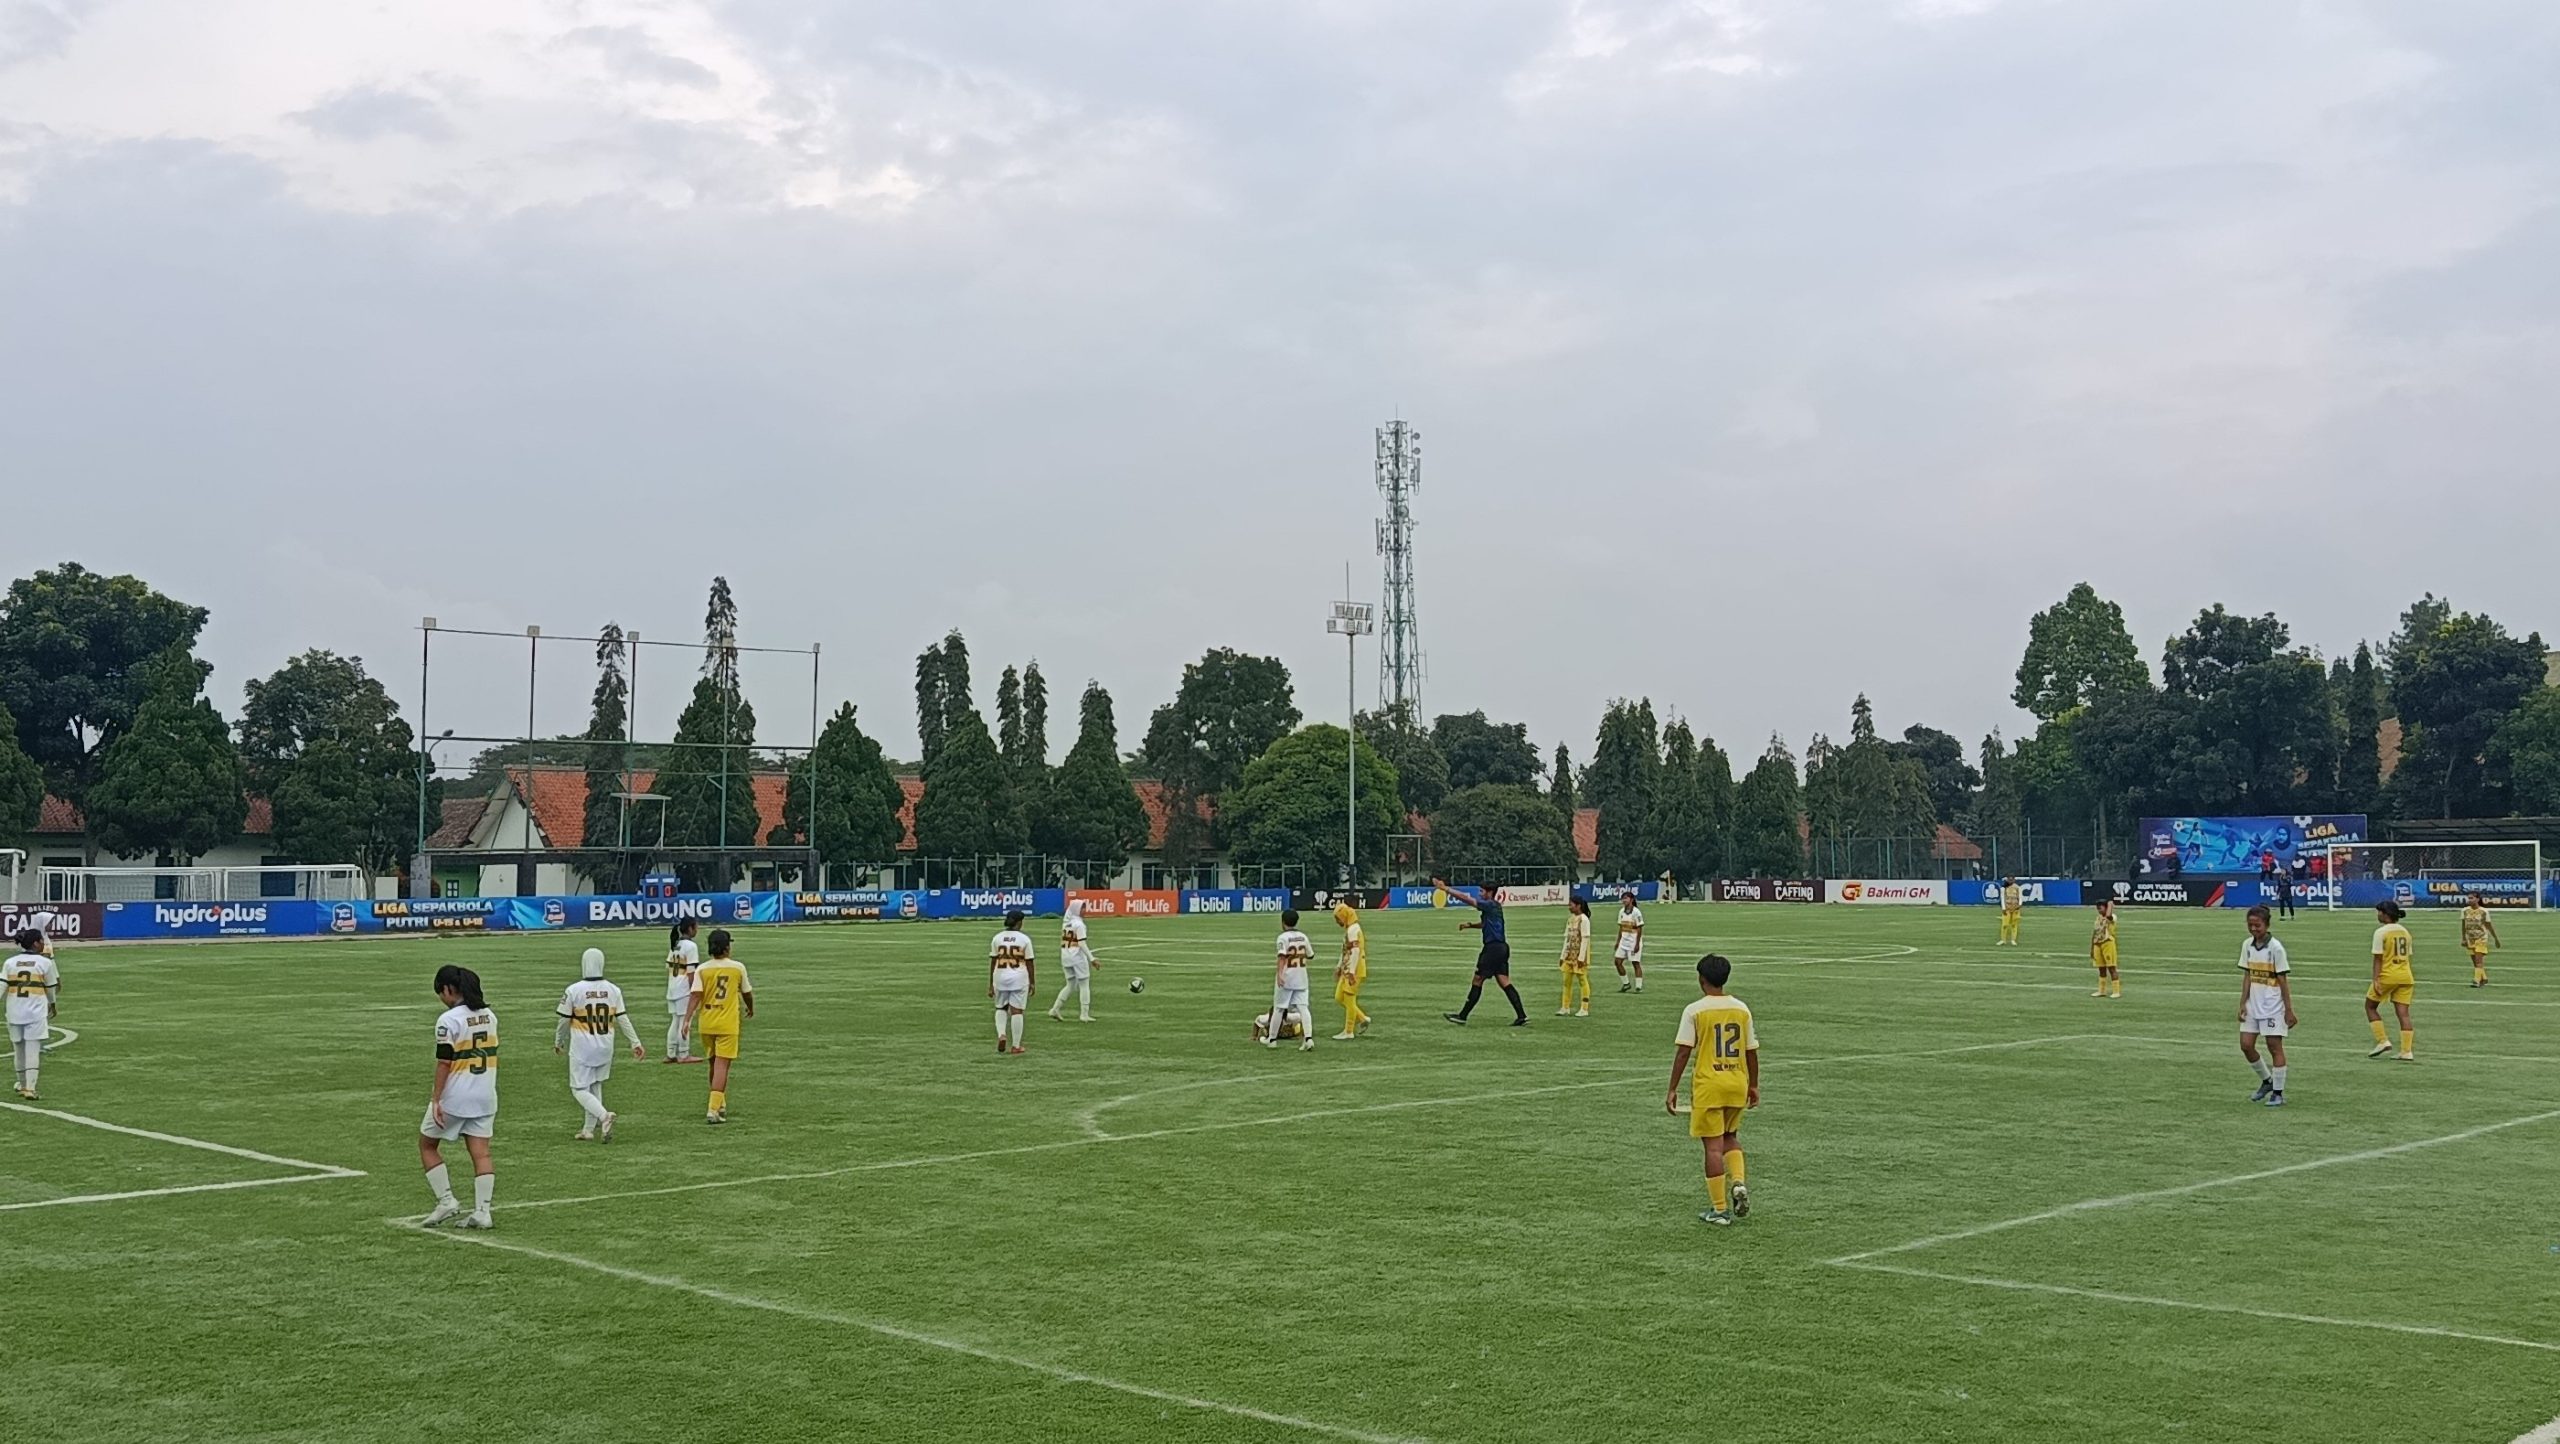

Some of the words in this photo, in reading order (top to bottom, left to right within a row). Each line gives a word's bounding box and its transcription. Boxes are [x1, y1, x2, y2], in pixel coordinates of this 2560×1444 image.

[2304, 822, 2338, 839] LIGA
[1592, 883, 1639, 900] hydroplus
[1723, 885, 1761, 900] CAFFINO
[1775, 886, 1814, 901] CAFFINO
[1867, 886, 1908, 898] Bakmi
[1909, 887, 1931, 898] GM
[2260, 882, 2343, 901] hyroplus
[2428, 882, 2459, 892] LIGA
[2462, 882, 2537, 892] SEPAKBOLA
[795, 893, 822, 904] LIGA
[825, 893, 888, 903] SEPAKBOLA
[961, 890, 1034, 910] hydroplus
[1201, 896, 1231, 912] blibli
[1254, 895, 1282, 912] blibli
[2133, 890, 2188, 902] GADJAH
[373, 902, 408, 915] LIGA
[412, 900, 494, 913] SEPAKBOLA
[589, 898, 713, 921] BANDUNG
[805, 905, 838, 916] PUTRI
[1126, 898, 1170, 913] MilkLife
[156, 903, 267, 928] hydroplus
[386, 916, 429, 928] PUTRI
[4, 913, 81, 937] CAINO
[2393, 936, 2407, 957] 18
[1287, 945, 1307, 968] 22
[17, 970, 31, 998] 2
[714, 975, 729, 1000] 5
[585, 1002, 610, 1036] 10
[1713, 1022, 1741, 1058] 12
[469, 1030, 488, 1075] 5
